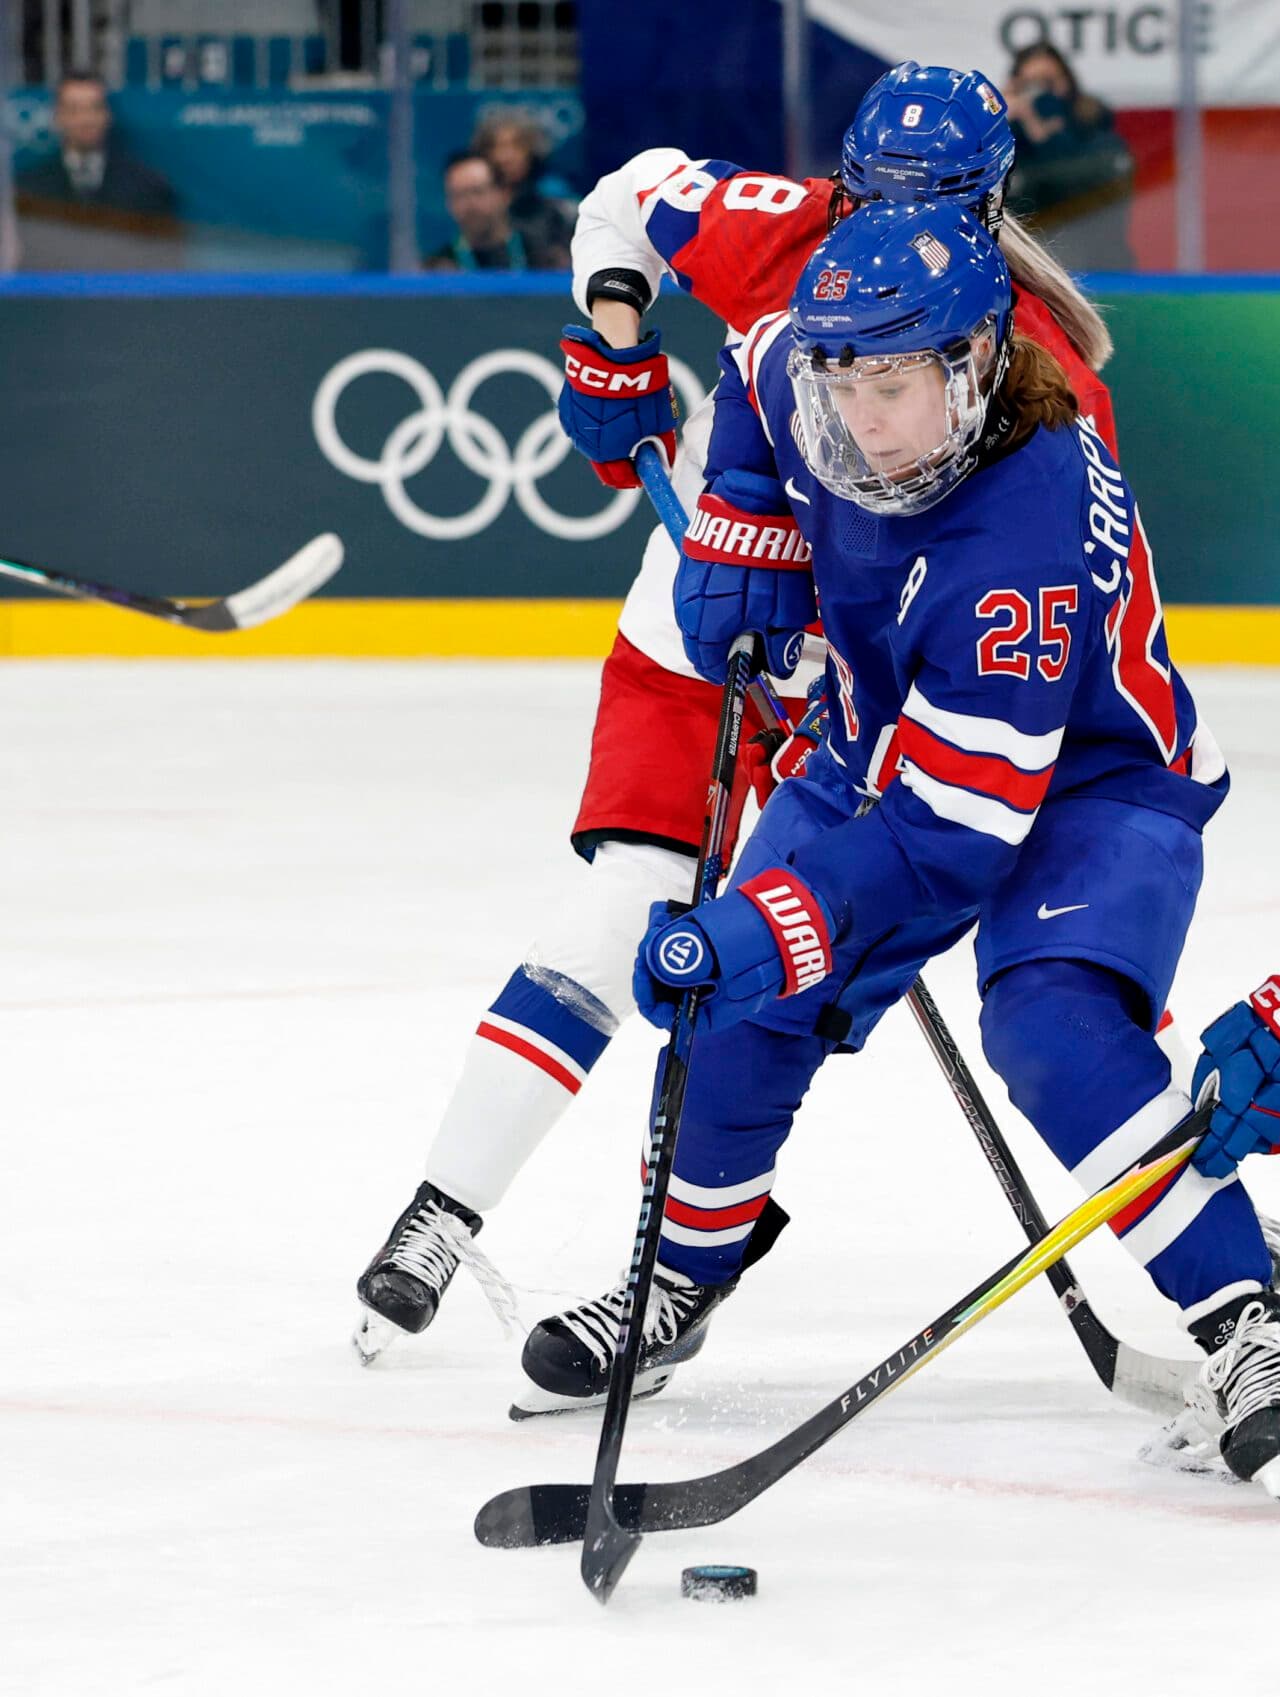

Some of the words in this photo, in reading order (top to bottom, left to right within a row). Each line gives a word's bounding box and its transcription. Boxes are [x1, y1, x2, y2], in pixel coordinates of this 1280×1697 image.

[902, 104, 924, 127] 8
[722, 176, 809, 214] 8
[914, 234, 931, 249] USA
[813, 269, 852, 301] 25
[565, 354, 652, 392] CCM
[975, 584, 1078, 683] 25
[1218, 1318, 1236, 1334] 25
[839, 1327, 936, 1415] FLYLITE
